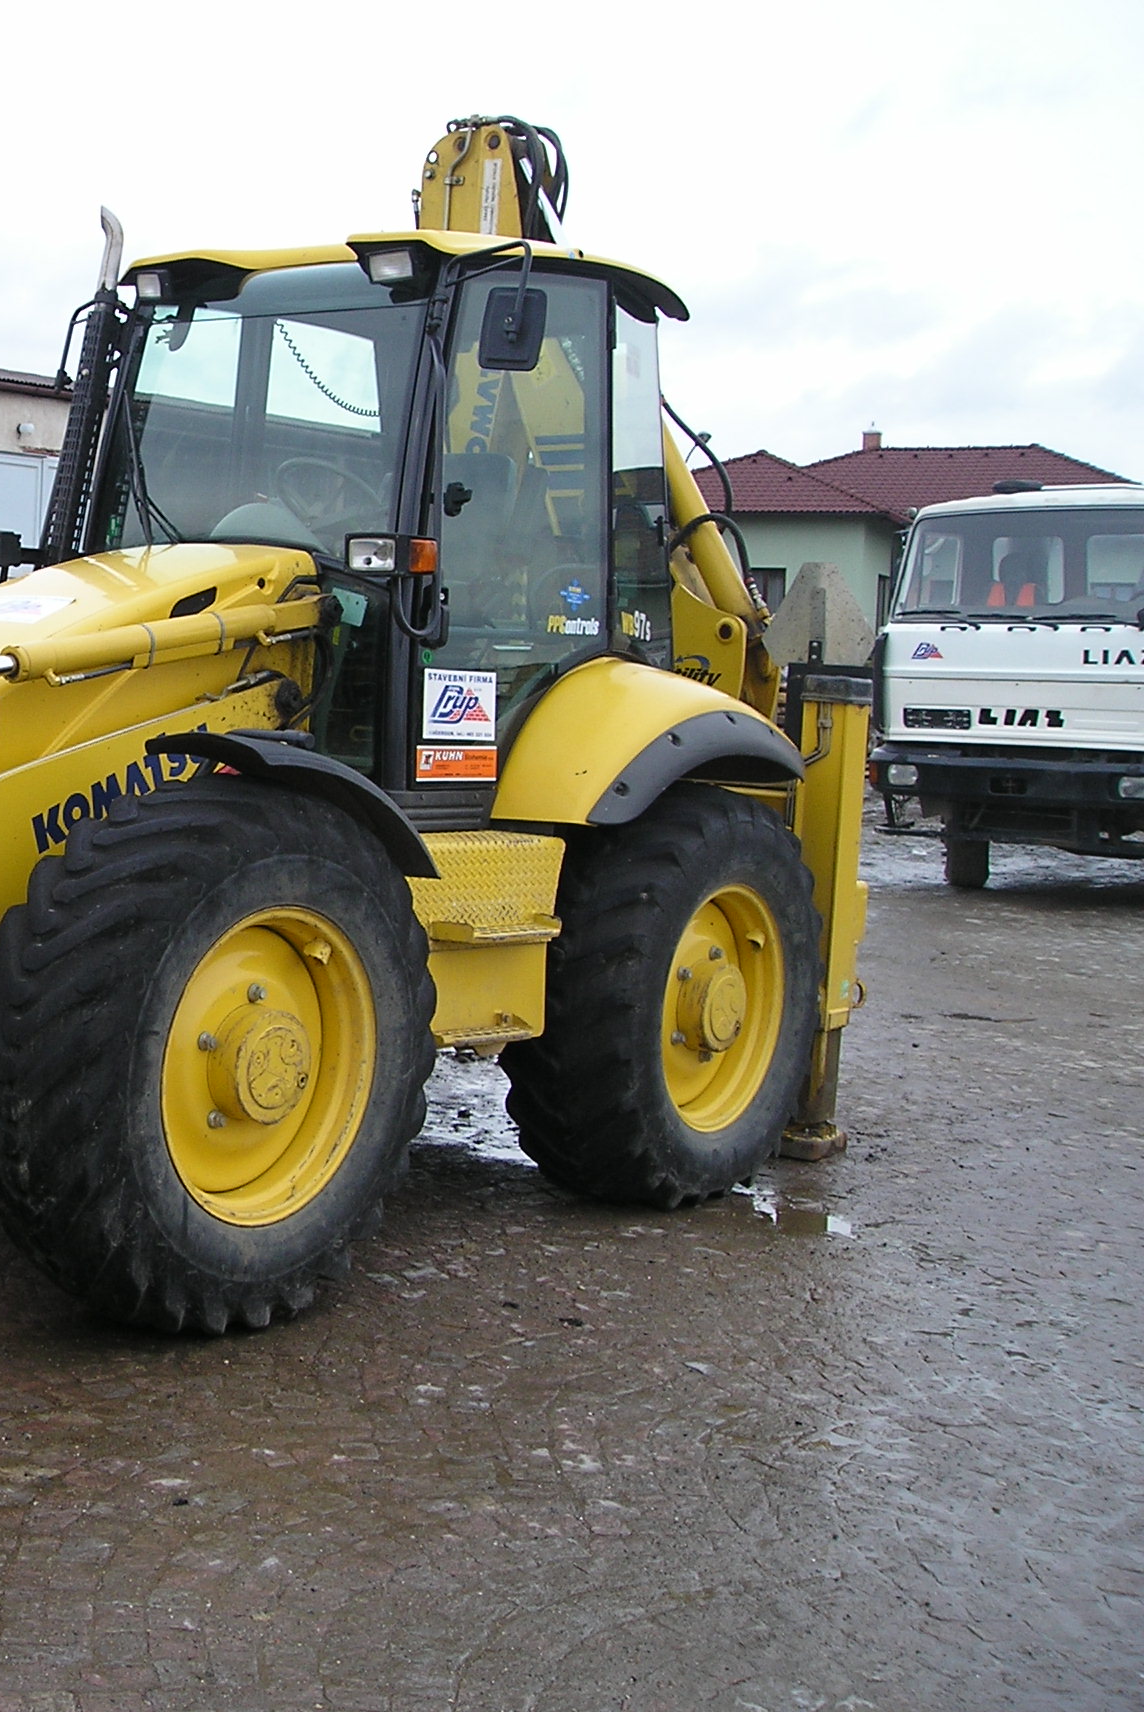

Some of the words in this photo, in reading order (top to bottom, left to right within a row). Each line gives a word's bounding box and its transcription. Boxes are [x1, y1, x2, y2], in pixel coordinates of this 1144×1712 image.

[1083, 649, 1144, 666] LIA
[469, 676, 493, 684] FIRMA
[673, 667, 722, 686] tility
[435, 750, 464, 761] KUHN
